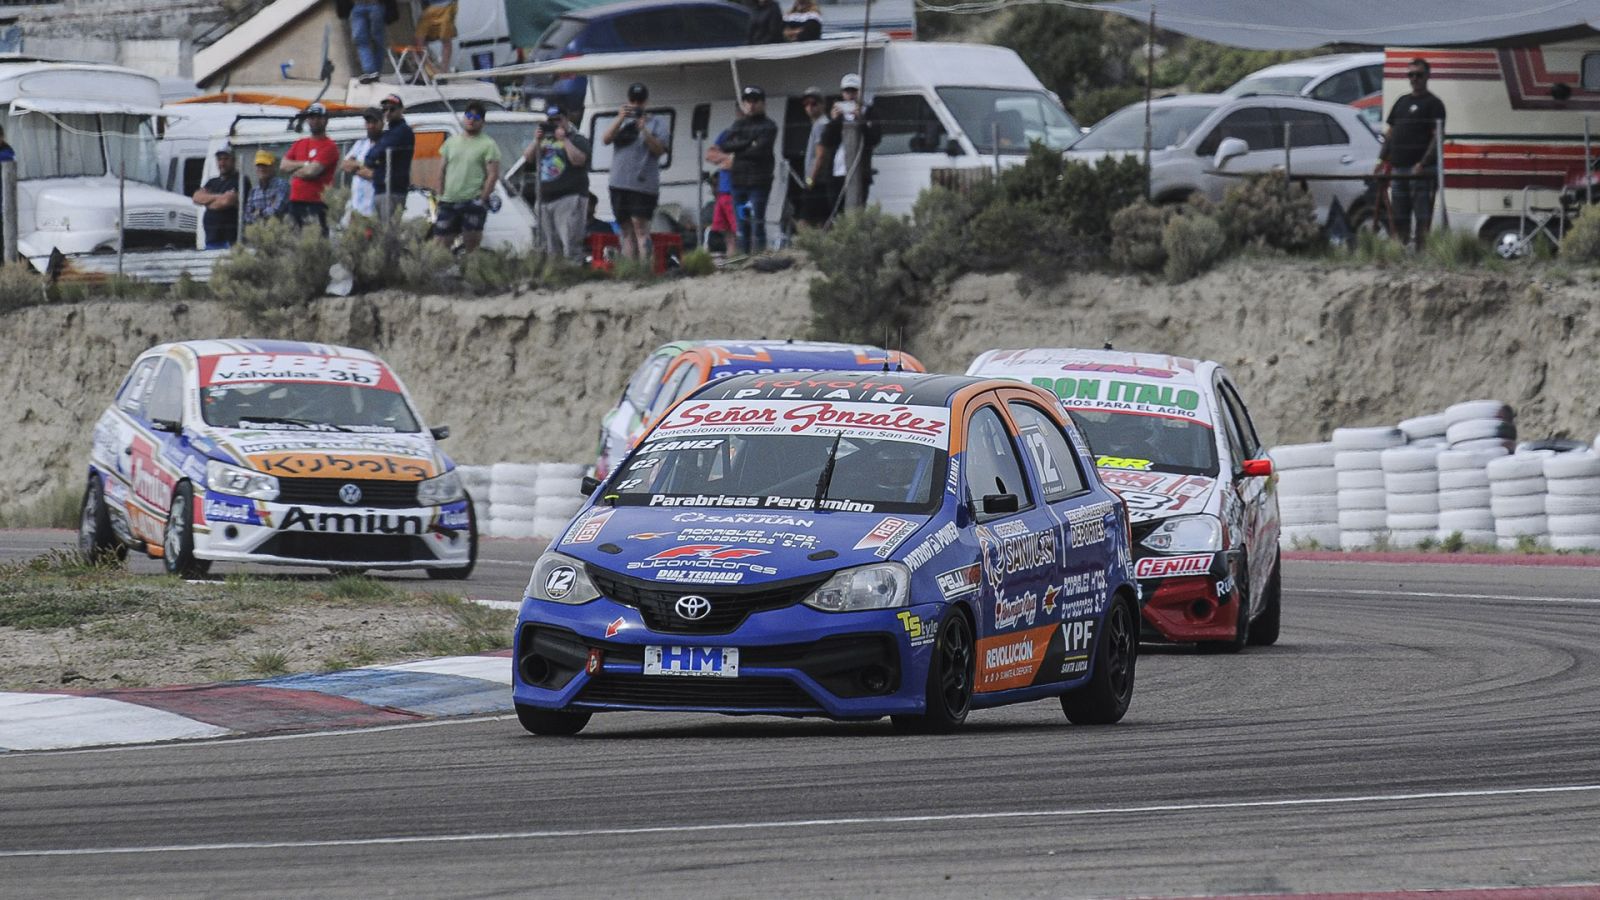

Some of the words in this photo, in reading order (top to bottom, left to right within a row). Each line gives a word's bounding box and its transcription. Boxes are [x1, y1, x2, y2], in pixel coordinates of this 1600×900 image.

[329, 370, 371, 384] 3b
[754, 380, 904, 392] TOYOTA
[1107, 380, 1200, 411] ITALO
[657, 403, 778, 430] Señor
[783, 402, 947, 433] González
[1096, 400, 1132, 409] PARA
[1157, 406, 1196, 417] AGRO
[652, 425, 741, 439] Concesionario
[745, 425, 787, 434] Oficial
[814, 427, 850, 436] Toyota
[869, 431, 895, 439] San
[904, 433, 936, 444] Juan
[636, 439, 725, 456] LEANEZ
[262, 454, 427, 480] Kubota
[629, 458, 660, 471] C2
[1026, 432, 1059, 484] 12
[948, 457, 960, 487] LEANEZ
[616, 477, 643, 491] 12
[649, 494, 760, 508] Parabrisas
[278, 506, 422, 535] Amiun
[874, 520, 903, 538] RED
[576, 522, 602, 541] RED
[676, 535, 775, 544] transportes
[681, 528, 765, 538] RODRIGUEZ
[771, 531, 821, 543] HNOS.
[1070, 518, 1105, 549] DEPORTES
[902, 541, 935, 573] PATRIOT
[935, 521, 960, 549] POWER
[626, 559, 778, 575] automotores
[697, 570, 754, 581] TERRADO
[1136, 555, 1212, 577] GENTILI
[547, 570, 575, 589] 12
[1061, 620, 1094, 652] YPF
[661, 646, 723, 671] HM
[985, 634, 1034, 669] REVOLUCIÓN
